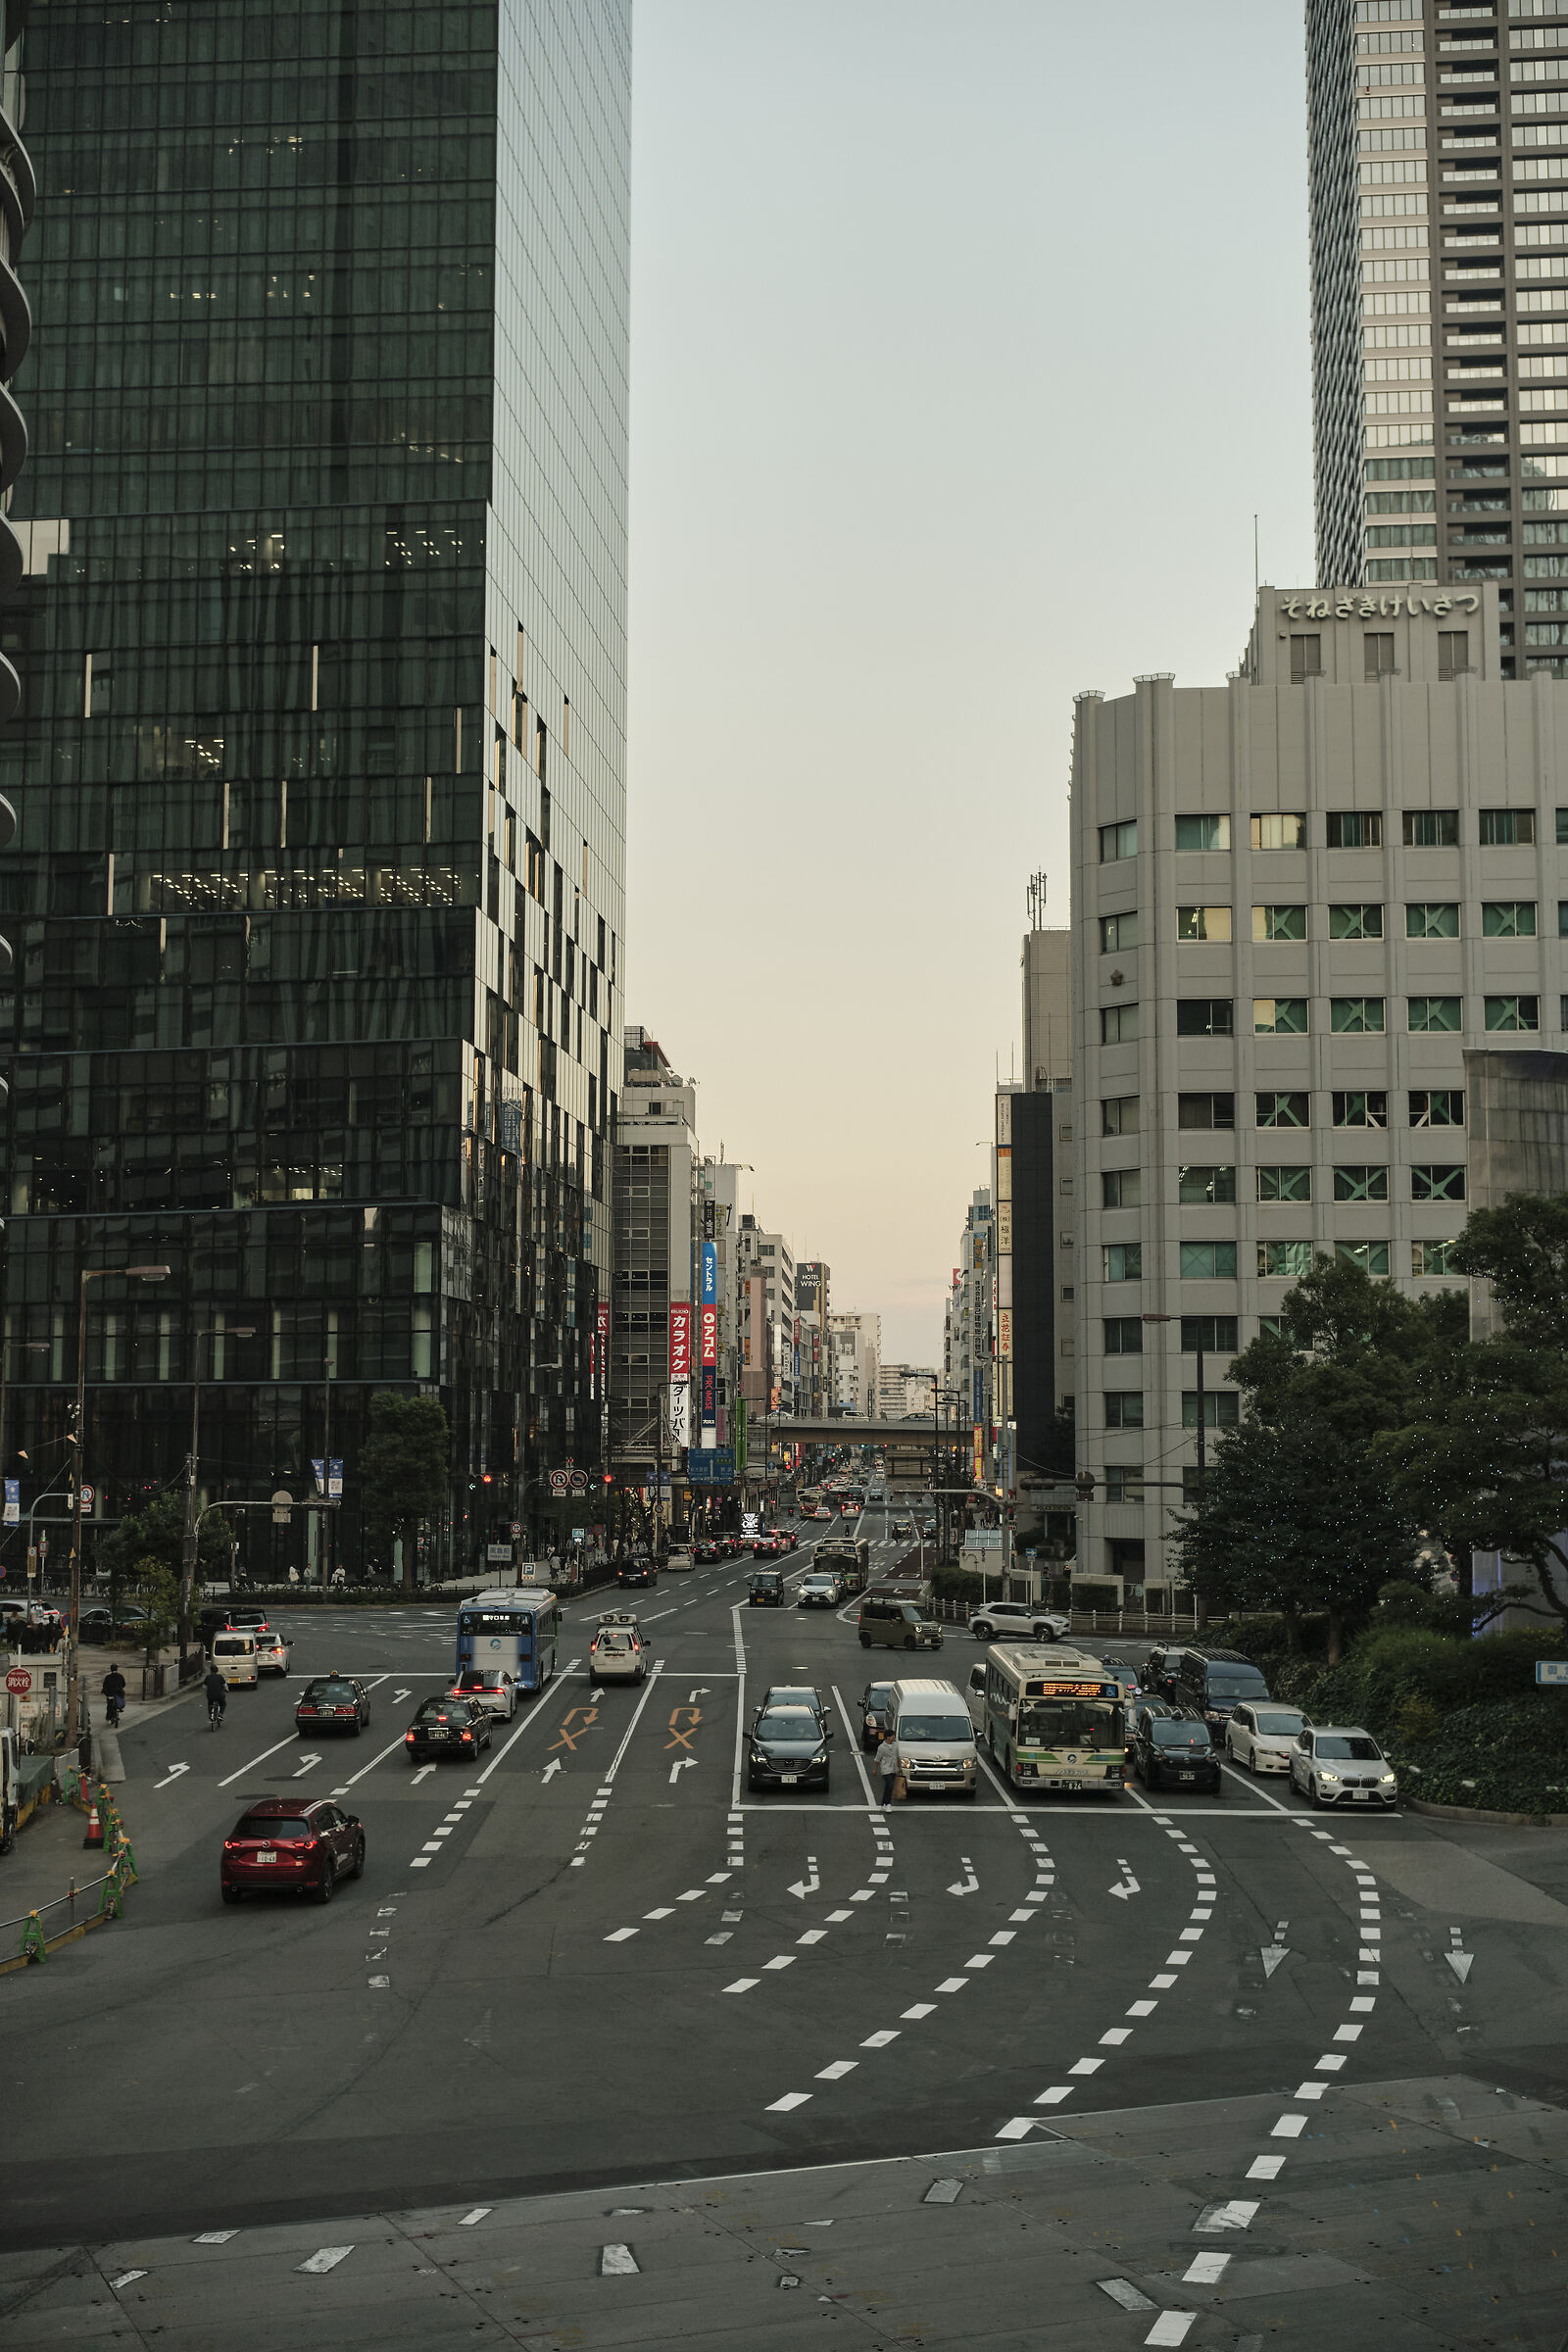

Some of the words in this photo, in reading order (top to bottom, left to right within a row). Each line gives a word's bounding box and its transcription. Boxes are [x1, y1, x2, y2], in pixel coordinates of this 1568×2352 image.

[1280, 594, 1479, 619] そねざきけいさつ
[705, 1256, 713, 1292] セントラル
[672, 1315, 687, 1372] カラオケ
[704, 1326, 715, 1358] アコム
[1001, 1312, 1010, 1352] 立花証券
[705, 1375, 713, 1411] PROMISE
[524, 1565, 533, 1574] P
[8, 1677, 29, 1688] 消火栓
